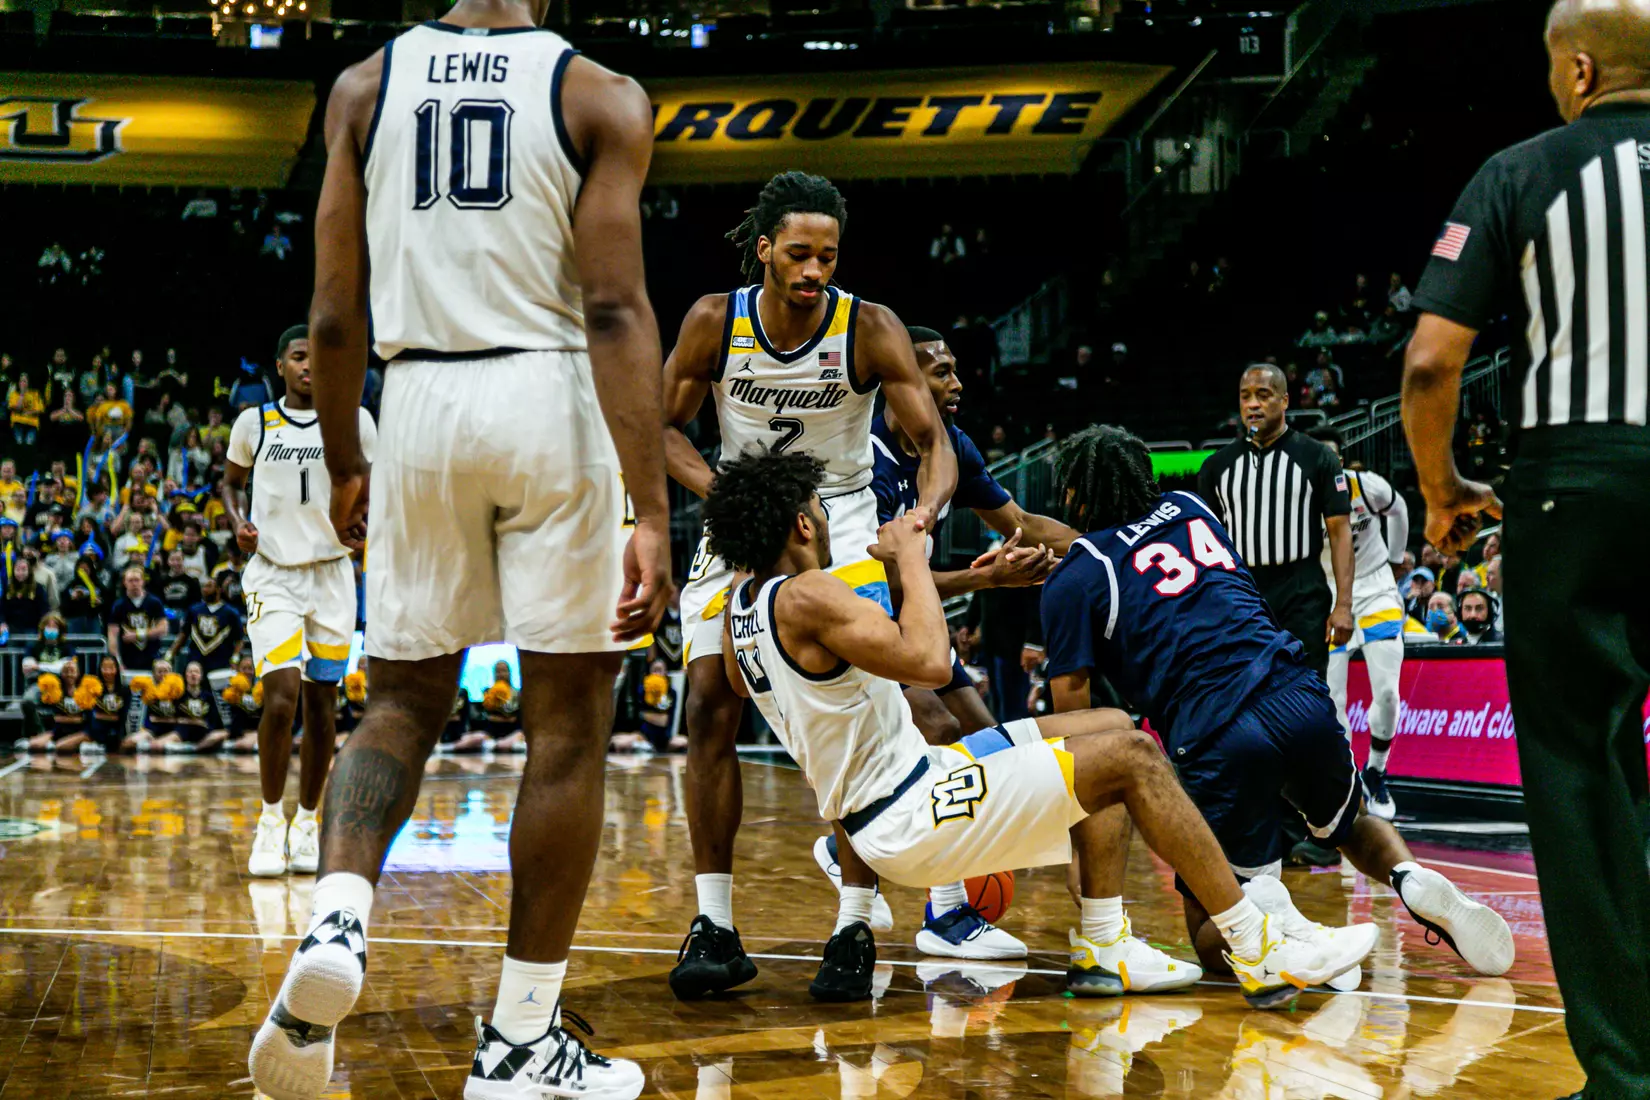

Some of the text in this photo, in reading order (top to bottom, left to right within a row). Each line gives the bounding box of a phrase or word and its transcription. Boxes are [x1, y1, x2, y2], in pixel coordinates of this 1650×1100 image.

[427, 52, 509, 83] LEWIS
[653, 92, 1103, 142] RQUETTE
[412, 98, 515, 210] 10
[729, 378, 849, 414] Marquette
[265, 444, 325, 465] Marque
[768, 417, 804, 456] 2
[300, 468, 310, 506] 1
[1116, 501, 1181, 547] LEWIS
[1132, 517, 1237, 597] 34
[1448, 702, 1491, 738] and
[1487, 701, 1516, 739] clo
[930, 763, 989, 831] MU
